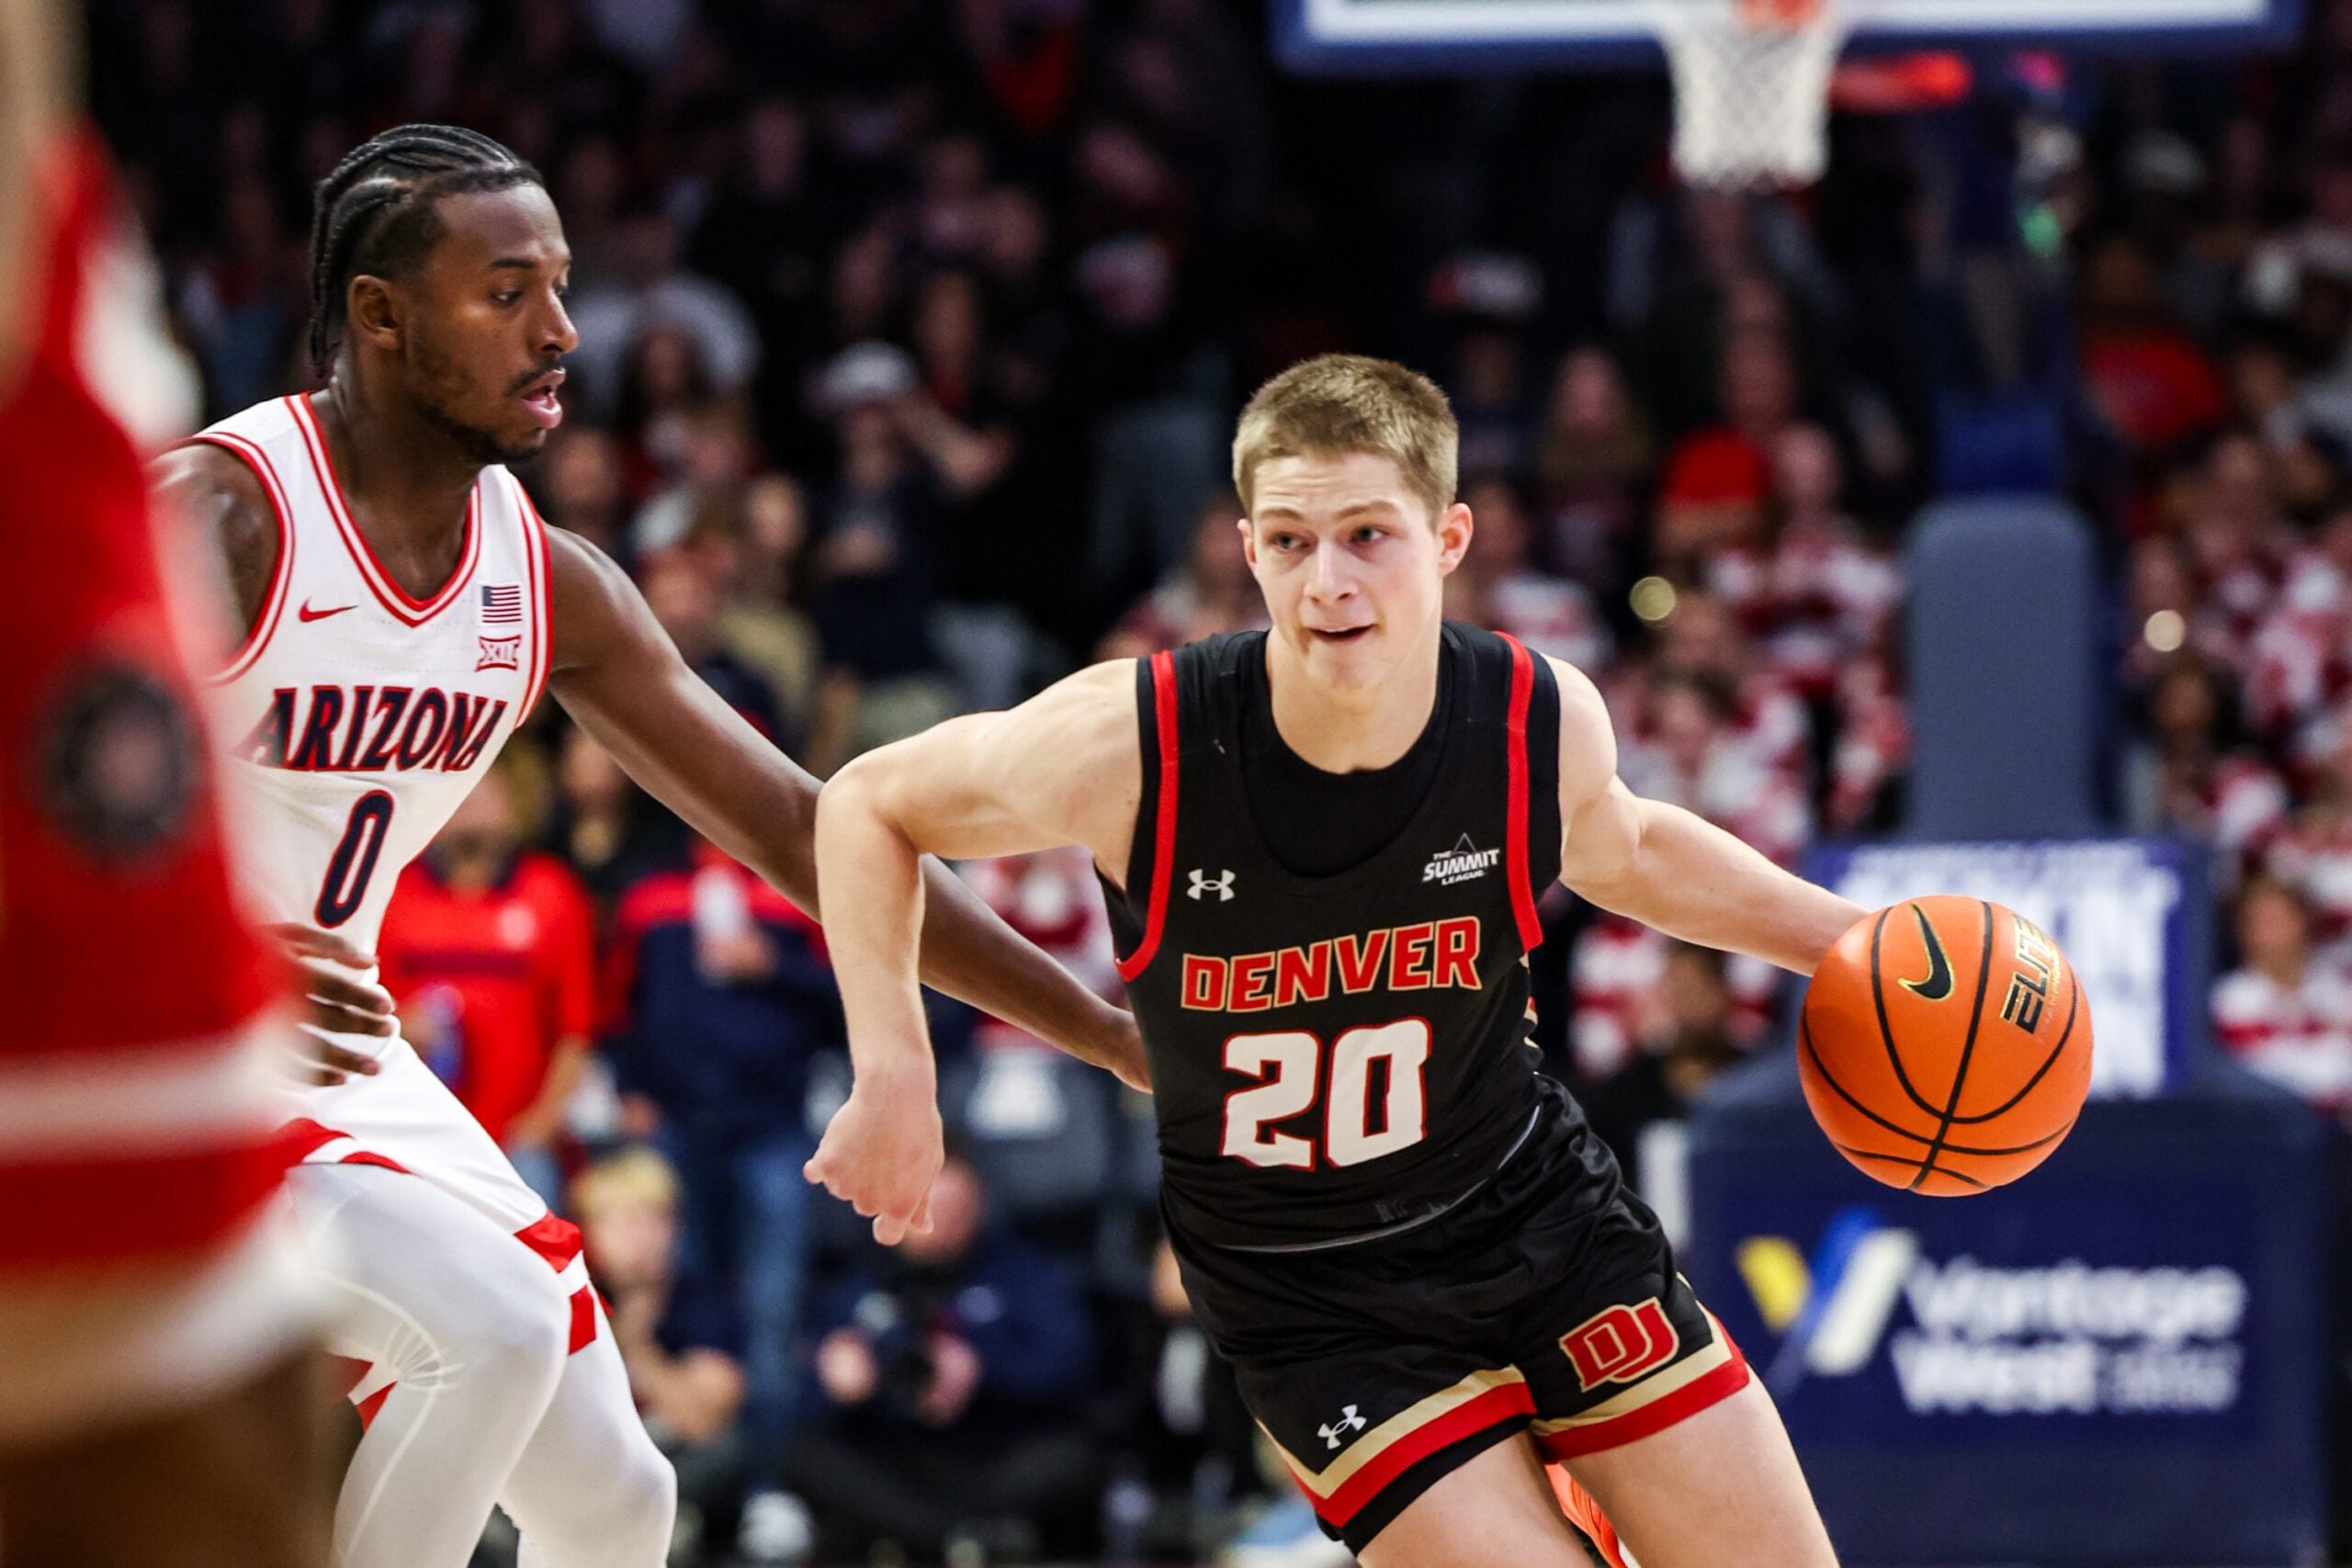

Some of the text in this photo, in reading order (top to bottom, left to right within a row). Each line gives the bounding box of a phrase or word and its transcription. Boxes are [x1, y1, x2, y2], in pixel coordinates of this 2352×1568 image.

[232, 684, 508, 773] ARIZONA
[314, 789, 393, 929] 0
[1421, 848, 1500, 883] SUMMIT
[1441, 869, 1486, 886] LEAGUE
[1181, 916, 1483, 1013] DENVER
[1999, 911, 2054, 1035] ELITE
[1219, 1016, 1432, 1172] 20
[1558, 1296, 1680, 1393] DU
